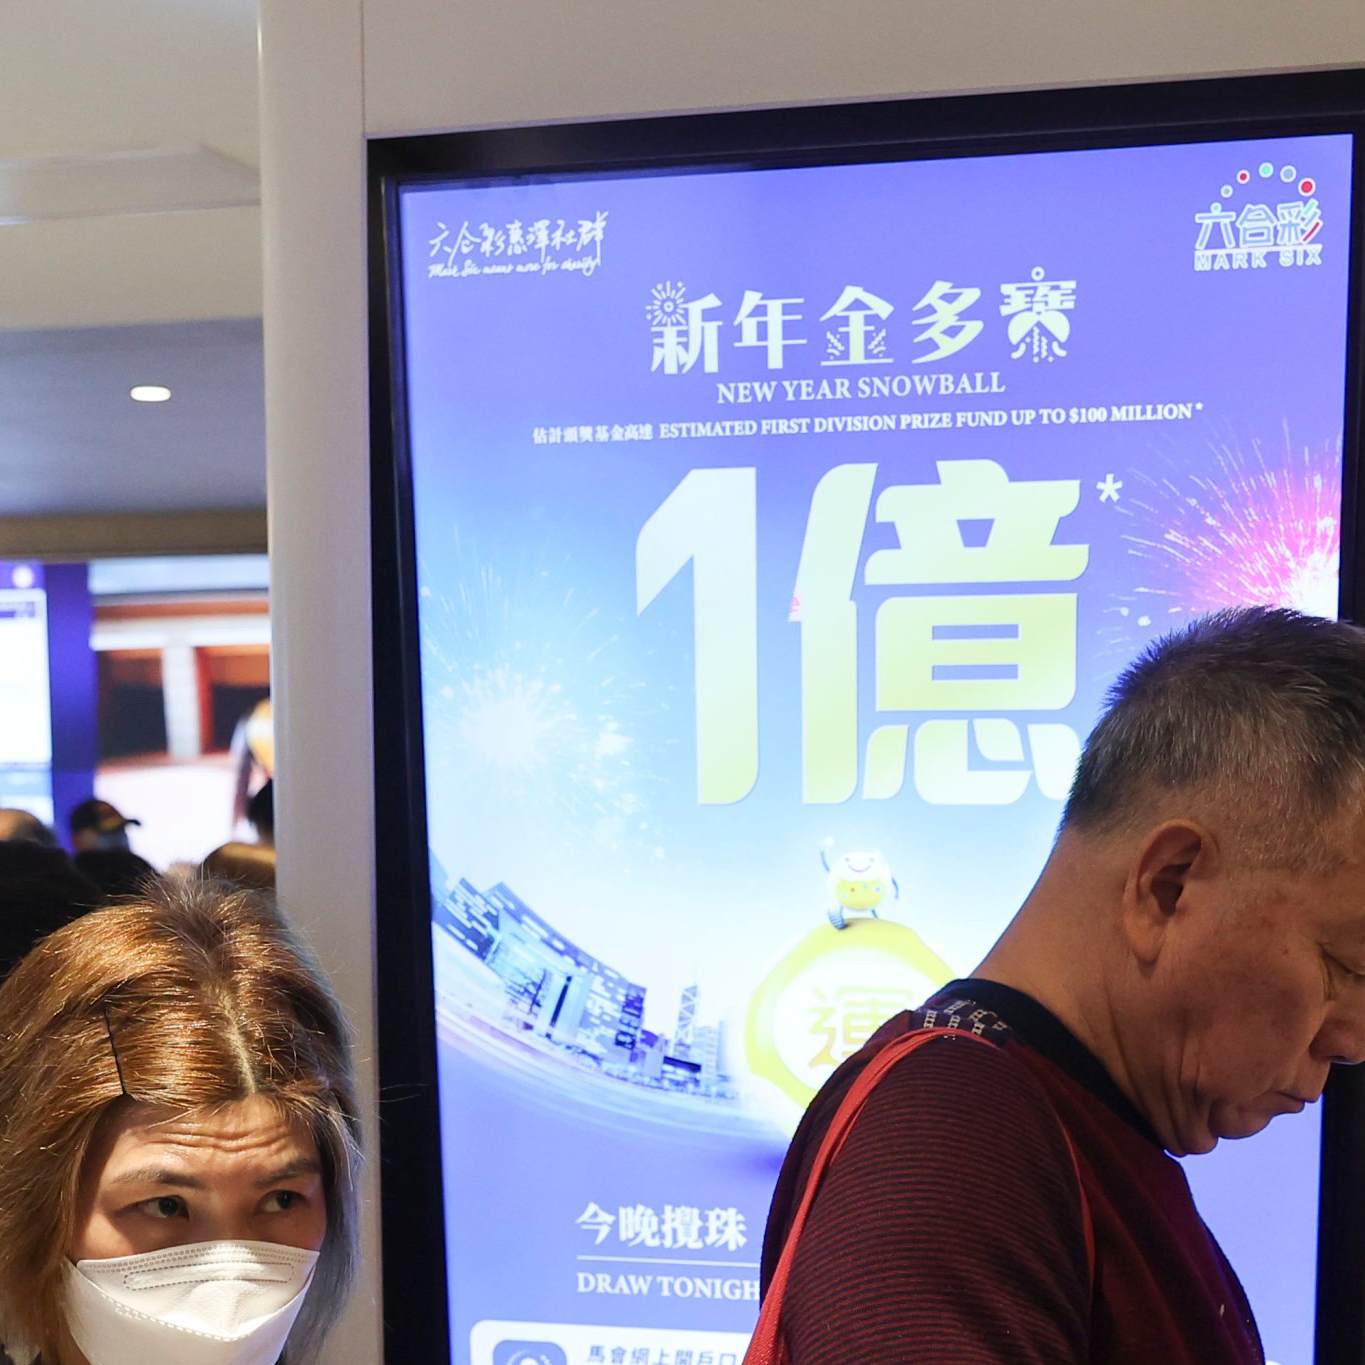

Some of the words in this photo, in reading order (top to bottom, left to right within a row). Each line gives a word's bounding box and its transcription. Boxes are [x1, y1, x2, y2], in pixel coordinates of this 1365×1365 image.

[1194, 198, 1324, 250] 六合彩
[1194, 250, 1268, 272] MARK
[1278, 248, 1323, 268] SIX
[645, 266, 1077, 375] 新年金多寶
[717, 379, 776, 404] NEW
[782, 377, 852, 402] YEAR
[856, 371, 1006, 399] SNOWBALL
[659, 419, 758, 439] ESTIMATED
[761, 417, 811, 435] FIRST
[813, 414, 896, 433] DIVISION
[900, 411, 952, 429] PRIZE
[955, 409, 1008, 427] FUND
[1011, 409, 1036, 426] UP
[1039, 407, 1066, 425] TO
[1069, 405, 1108, 424] $100
[575, 1201, 748, 1252] 今晚攪珠
[577, 1271, 653, 1297] DRAW
[656, 1274, 761, 1301] TONIGH
